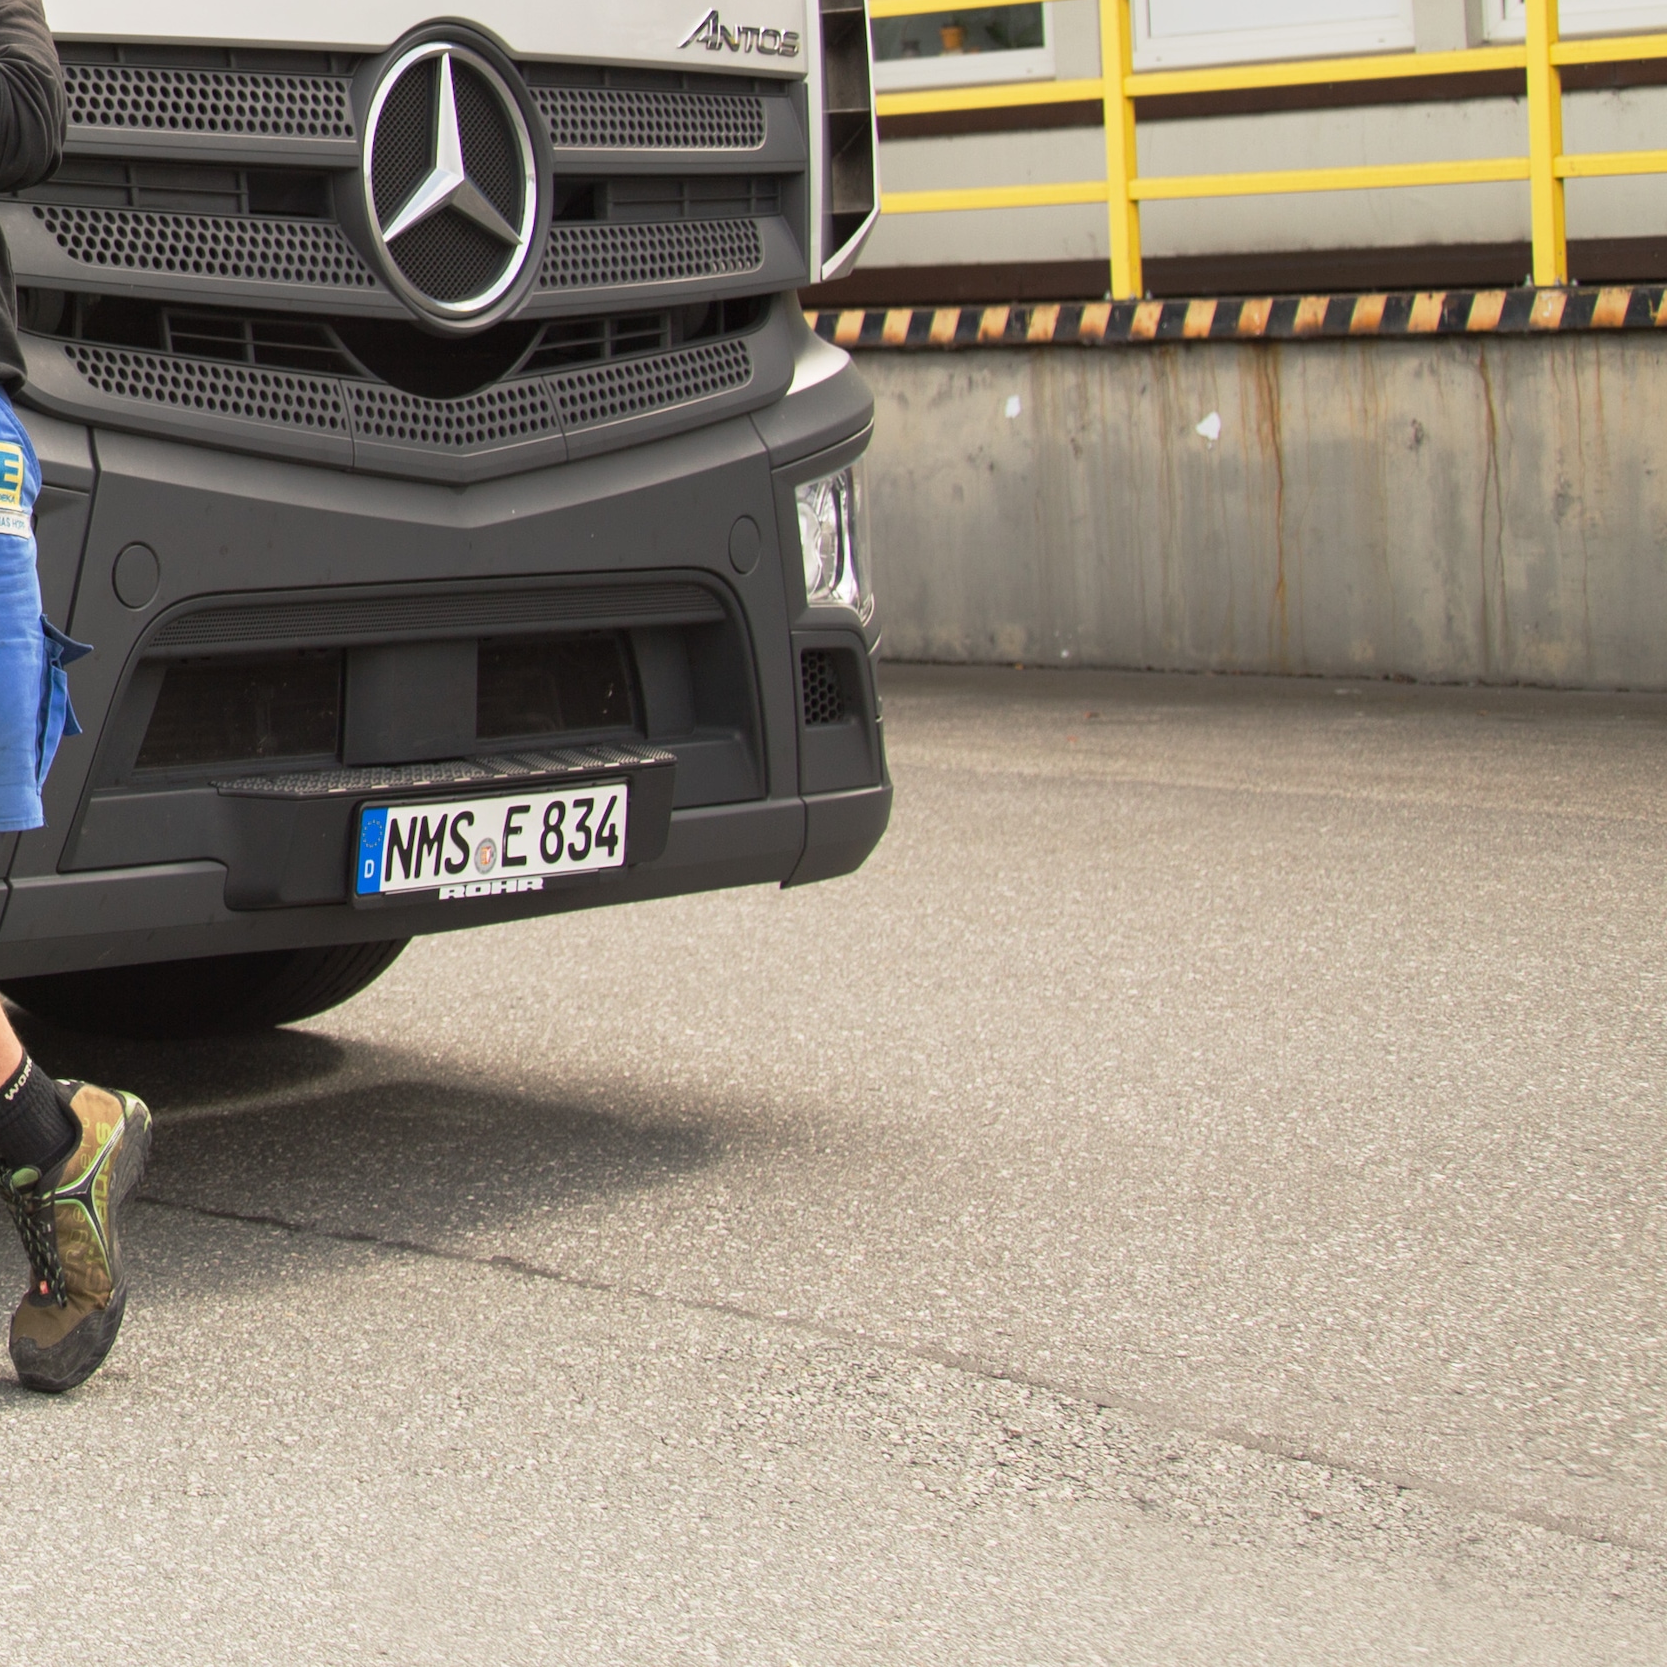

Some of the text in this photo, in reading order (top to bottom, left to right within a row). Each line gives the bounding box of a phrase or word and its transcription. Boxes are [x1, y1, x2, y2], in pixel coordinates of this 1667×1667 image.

[384, 795, 619, 883] NMS E 834
[364, 859, 375, 879] D
[438, 877, 544, 901] ROHR
